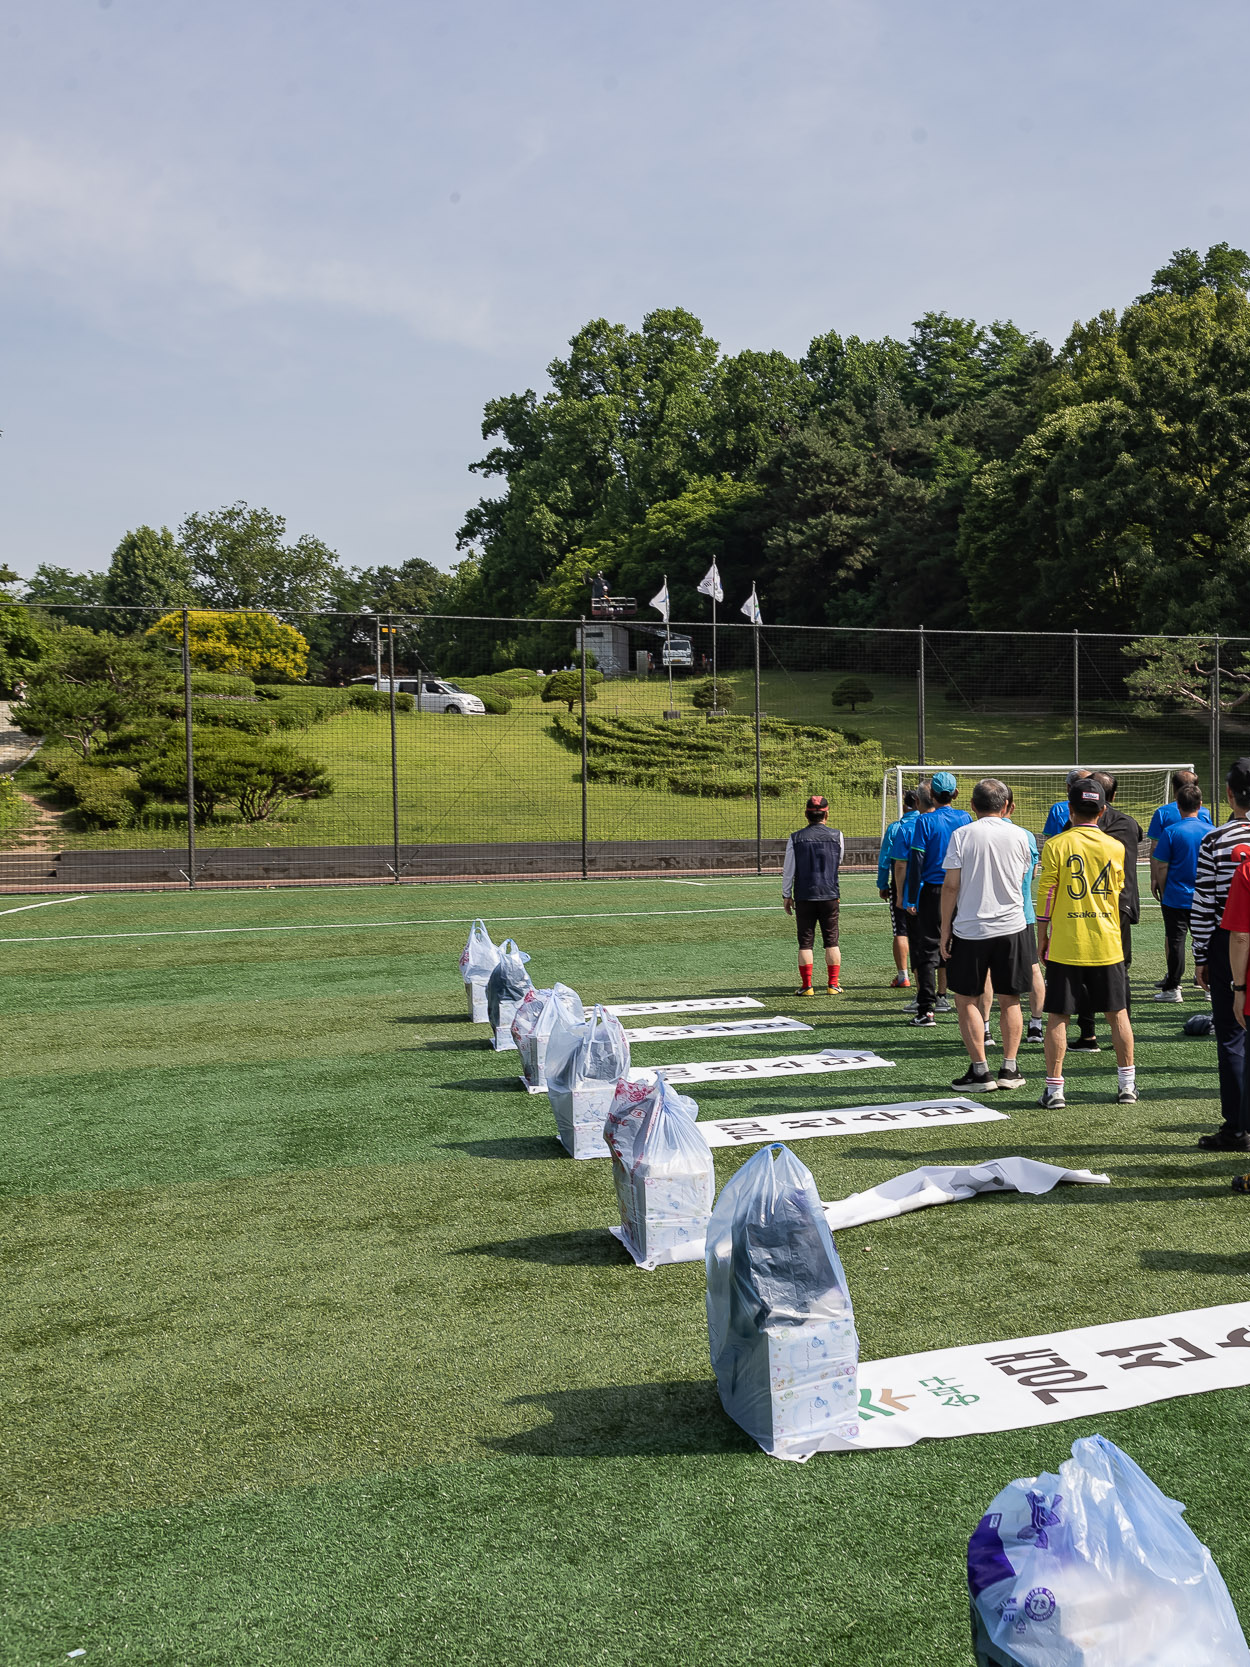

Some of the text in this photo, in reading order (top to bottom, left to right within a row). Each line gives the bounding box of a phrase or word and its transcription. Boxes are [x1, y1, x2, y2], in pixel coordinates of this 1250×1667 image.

[1066, 854, 1114, 900] 34
[780, 1104, 976, 1130] 선수단
[918, 1375, 981, 1408] 송파구
[984, 1347, 1108, 1406] 70대
